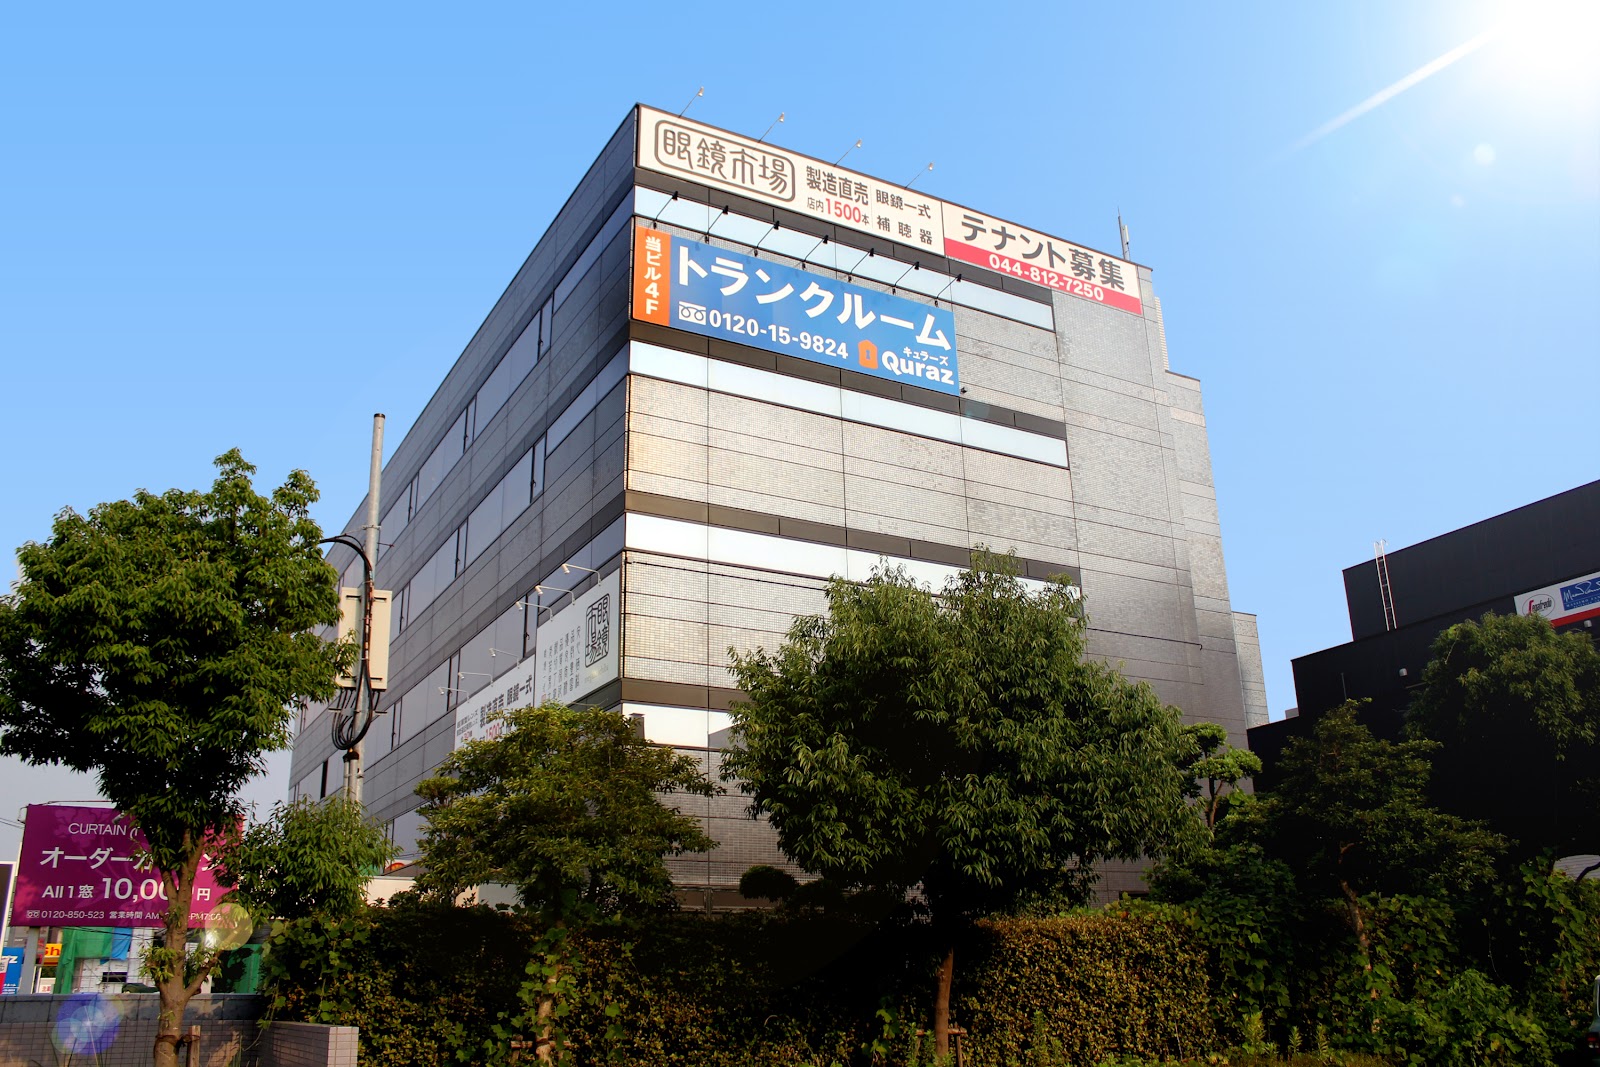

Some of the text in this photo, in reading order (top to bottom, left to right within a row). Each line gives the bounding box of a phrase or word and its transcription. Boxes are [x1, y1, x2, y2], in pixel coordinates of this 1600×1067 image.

[662, 128, 788, 195] 眼鏡市場
[805, 165, 869, 206] 製造直売
[875, 188, 932, 219] 眼鏡一式
[961, 213, 1126, 292] テナント募集
[644, 235, 662, 316] 当ビル4F
[988, 253, 1104, 302] 044-812-7250
[678, 245, 952, 352] トランクルーム
[708, 305, 849, 360] 0120-15-9824
[881, 350, 955, 386] Quraz
[902, 346, 949, 367] キュラーズ
[68, 822, 127, 837] CURTAIN
[41, 910, 105, 920] 0120-850-523
[109, 910, 143, 920] 営業時間
